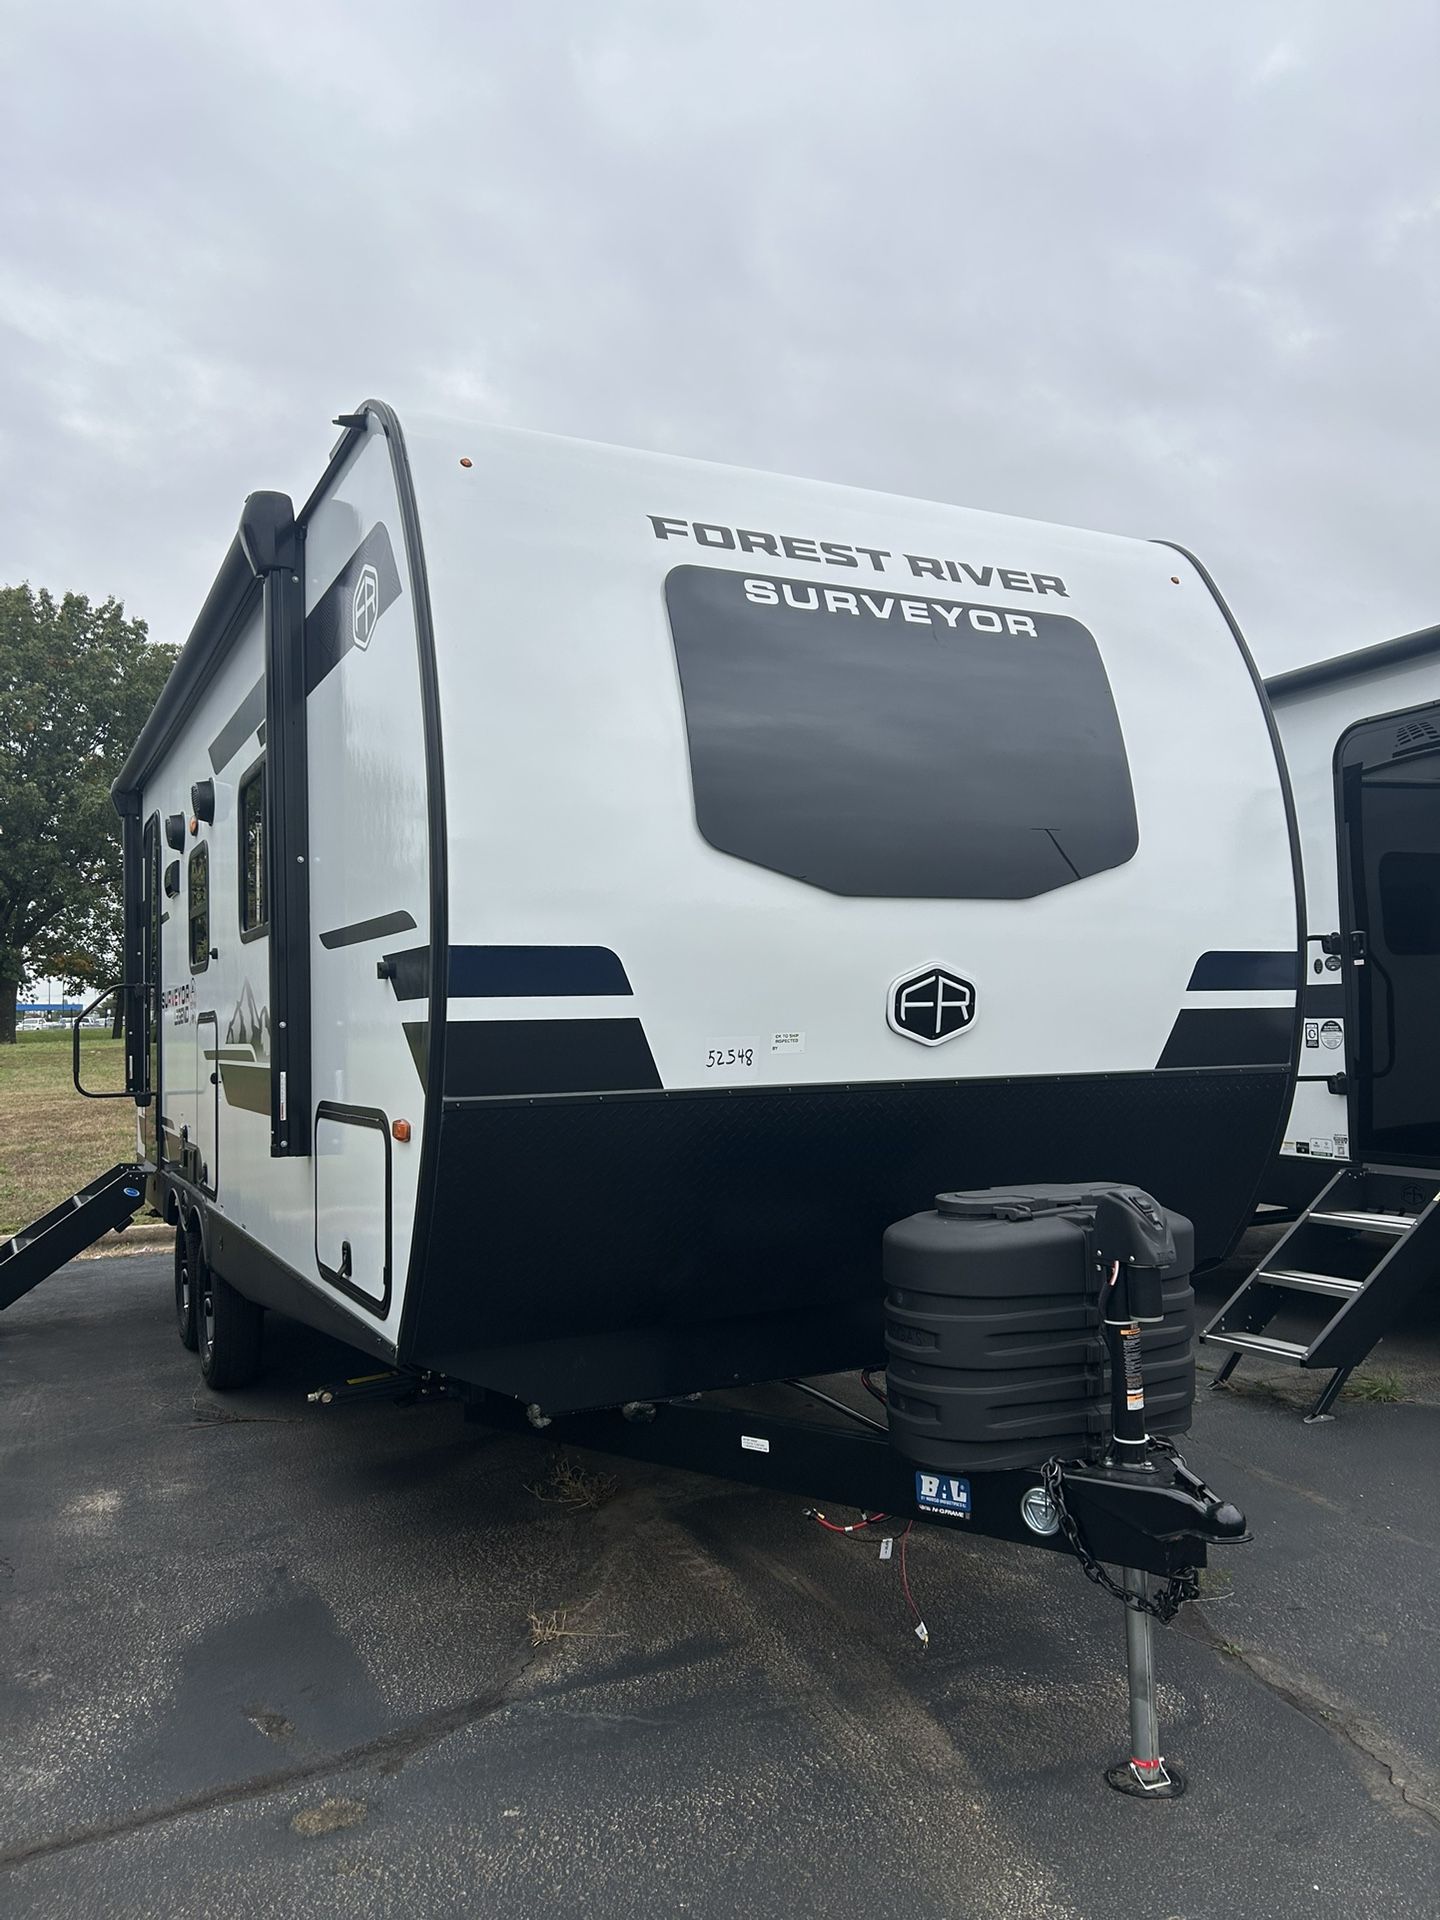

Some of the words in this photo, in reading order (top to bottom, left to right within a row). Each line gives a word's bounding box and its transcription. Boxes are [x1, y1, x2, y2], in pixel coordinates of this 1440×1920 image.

[646, 514, 892, 573] FOREST
[901, 552, 1071, 599] RIVER
[743, 578, 1039, 638] SURVEYOR
[706, 1048, 754, 1068] 52548
[920, 1474, 967, 1503] BAL
